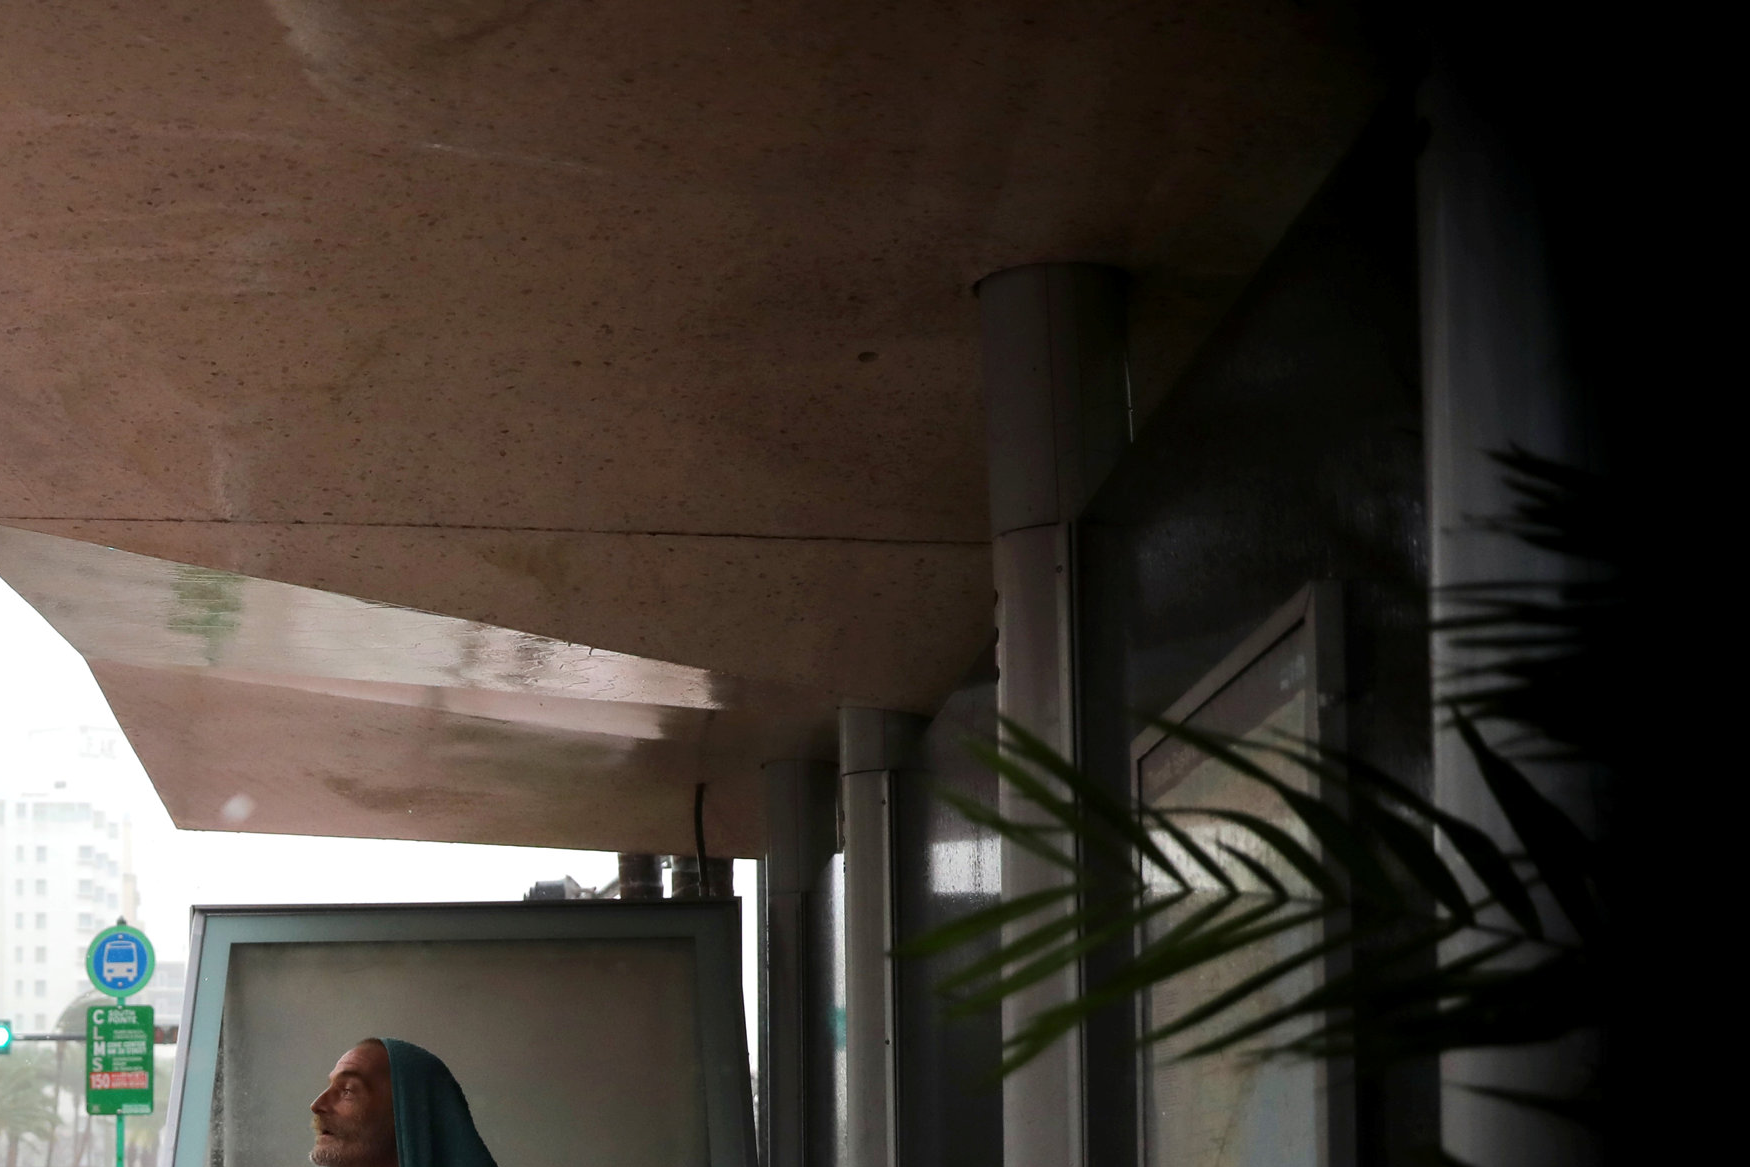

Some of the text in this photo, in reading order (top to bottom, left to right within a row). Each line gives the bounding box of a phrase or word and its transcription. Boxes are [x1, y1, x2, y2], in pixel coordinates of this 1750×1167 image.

[93, 1009, 105, 1024] C
[93, 1026, 104, 1040] L
[93, 1041, 106, 1056] M
[92, 1057, 103, 1071] S
[91, 1073, 110, 1089] 150
